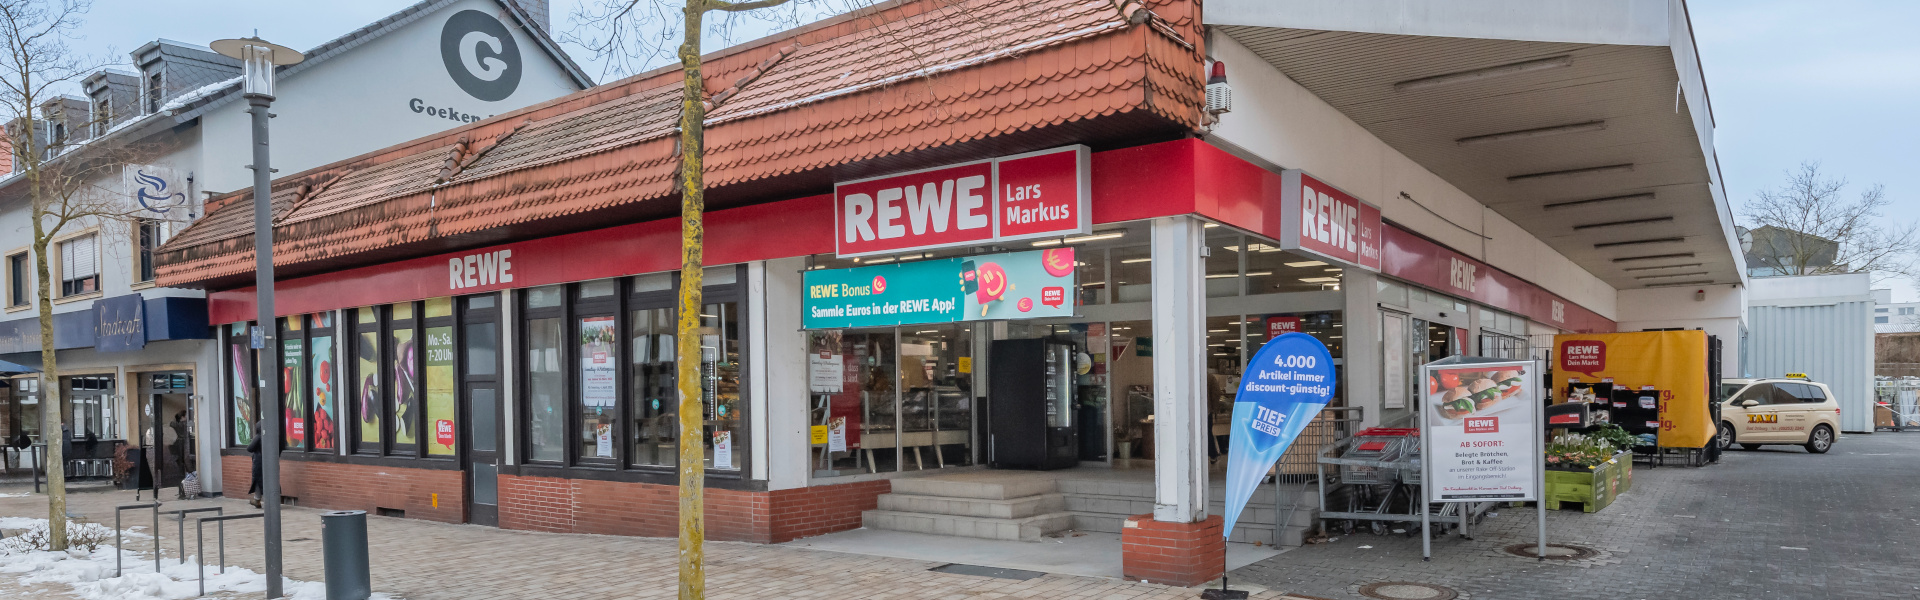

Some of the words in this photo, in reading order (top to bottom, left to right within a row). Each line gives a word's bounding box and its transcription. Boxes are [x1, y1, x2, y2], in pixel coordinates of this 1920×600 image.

[458, 31, 508, 81] G
[409, 98, 480, 123] Goeken
[1006, 183, 1042, 202] Lars
[844, 174, 988, 243] REWE
[1006, 202, 1070, 226] Markus
[1302, 185, 1356, 253] REWE
[1362, 222, 1372, 239] Lars
[1362, 240, 1378, 260] Markus
[449, 249, 513, 290] REWE
[1450, 256, 1476, 293] REWE
[810, 284, 838, 298] REWE
[842, 284, 870, 298] Bonus
[812, 305, 844, 318] Sammle
[846, 304, 870, 316] Euros
[872, 303, 881, 315] in
[883, 302, 898, 314] der
[900, 299, 929, 313] REWE
[932, 297, 955, 314] App!
[1552, 300, 1564, 324] REWE
[428, 349, 443, 361] 7-20
[1568, 346, 1599, 354] REWE
[1274, 355, 1316, 368] 4.000
[1259, 370, 1291, 380] Artikel
[1294, 371, 1325, 382] immer
[1246, 382, 1330, 397] discount-günstig!
[1257, 405, 1286, 426] TIEF
[1747, 414, 1778, 423] TAXI
[1255, 422, 1277, 435] PREIS
